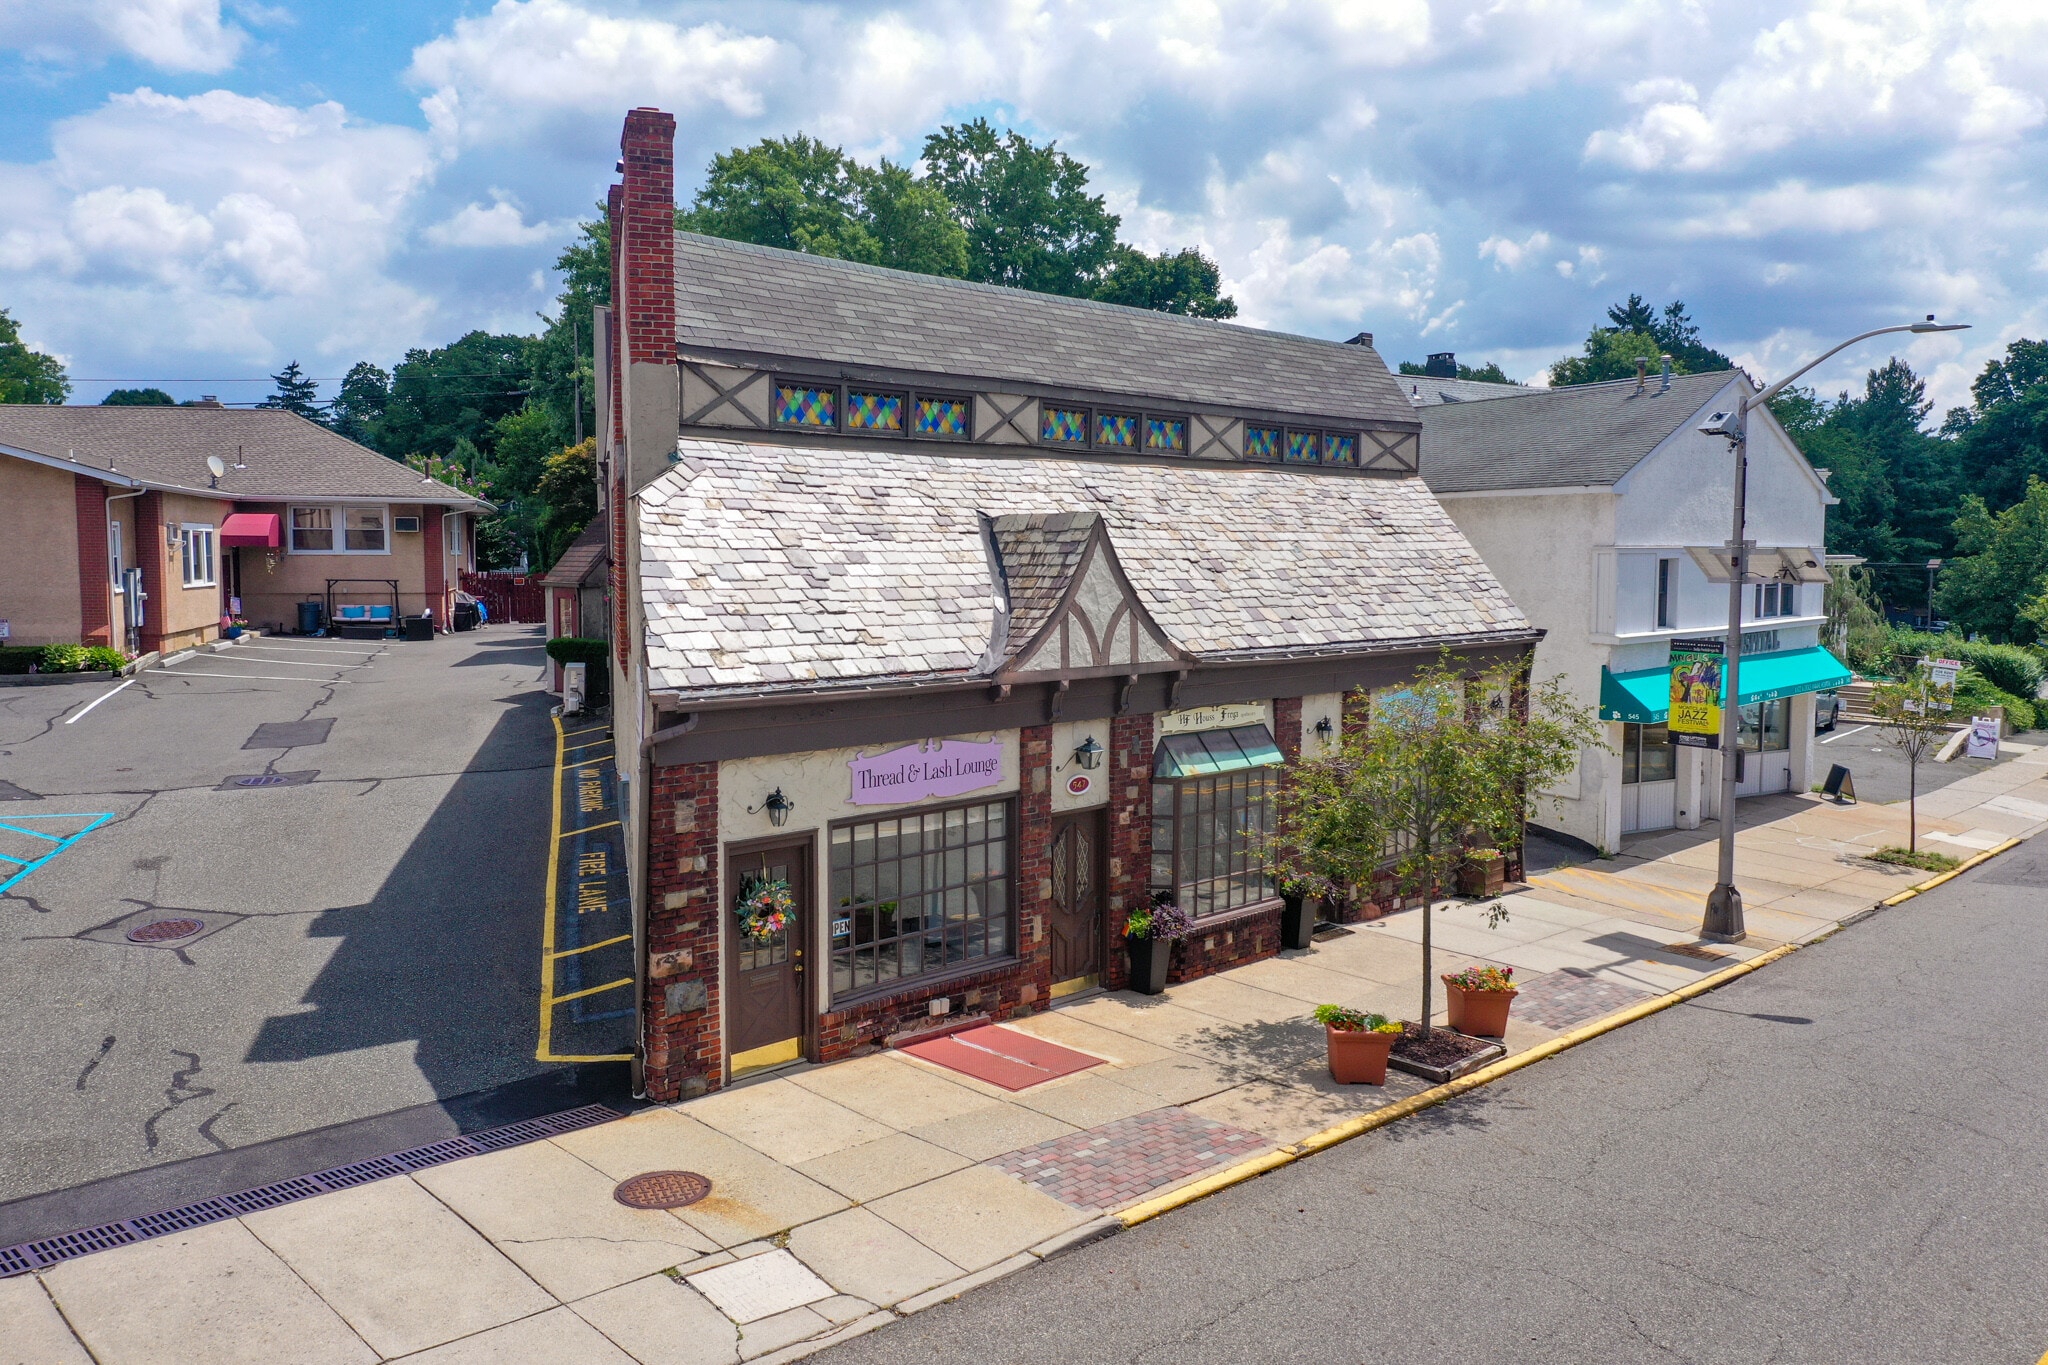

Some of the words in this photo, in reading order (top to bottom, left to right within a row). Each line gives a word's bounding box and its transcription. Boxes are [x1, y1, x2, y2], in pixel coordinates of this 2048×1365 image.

[1740, 630, 1780, 653] SPITAL
[1678, 710, 1708, 720] JAZZ
[579, 768, 600, 778] NO
[858, 765, 905, 789] Thread
[908, 763, 920, 783] &
[924, 759, 952, 781] Lash
[956, 758, 998, 776] Lounge
[579, 781, 603, 812] PARKING
[579, 852, 606, 876] FIRE
[579, 882, 607, 913] LANE
[834, 920, 850, 934] PEN
